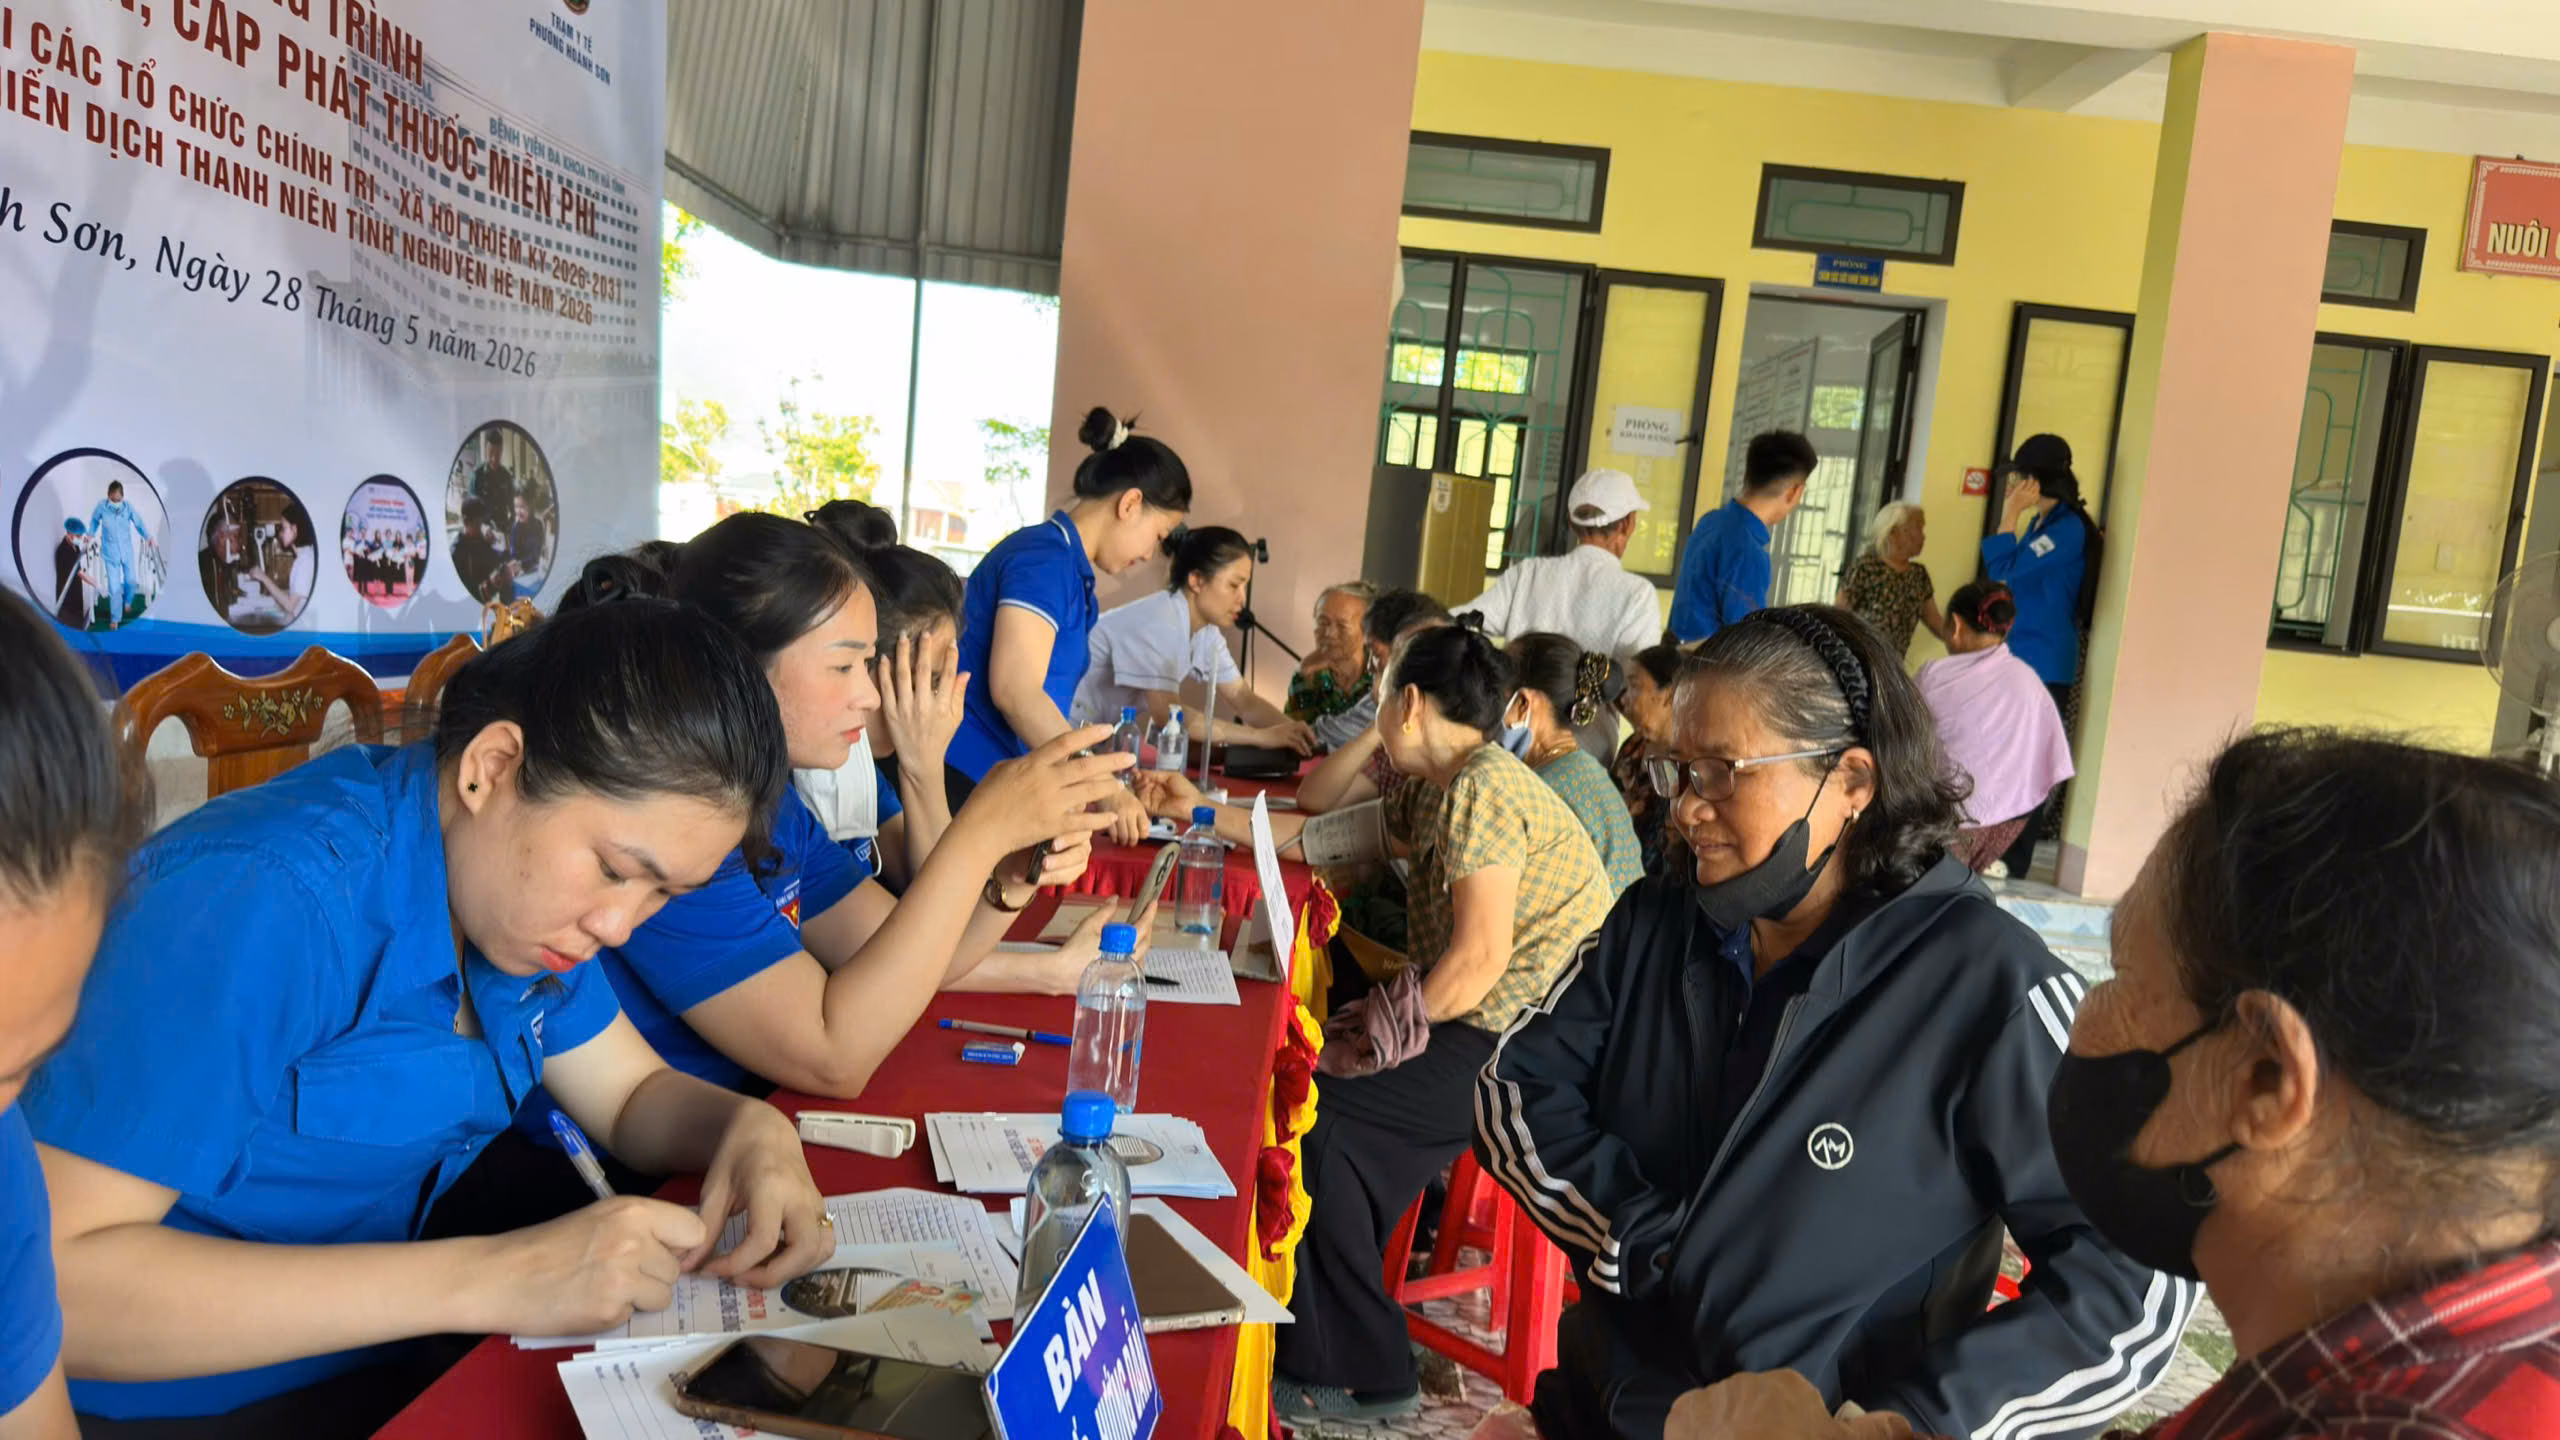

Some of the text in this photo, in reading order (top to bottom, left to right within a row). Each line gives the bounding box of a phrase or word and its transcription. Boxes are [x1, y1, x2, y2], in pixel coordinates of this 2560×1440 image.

[0, 65, 69, 133] IẾN
[86, 102, 163, 168] DỊCH
[176, 138, 269, 208] THANH
[279, 180, 337, 233] NIÊN
[494, 265, 514, 299] HÈ
[520, 276, 554, 313] NĂM
[559, 293, 593, 326] 2026
[31, 21, 102, 87] CÁC
[117, 58, 156, 109] TỔ
[169, 84, 245, 148] CHỨC
[257, 123, 333, 186] CHÍNH
[342, 160, 375, 212] TRỊ
[400, 186, 424, 226] XÃ
[431, 202, 461, 245] HỘI
[469, 218, 522, 265] NHIỆM
[528, 242, 547, 274] KỲ
[552, 255, 622, 304] 2026-2031
[278, 33, 371, 129] PHÁT
[384, 91, 478, 182] THUỐC
[560, 186, 597, 239] PHÍ
[43, 202, 137, 271] Sơn,
[155, 235, 250, 304] Ngày
[261, 270, 302, 312] 28
[316, 285, 395, 345] Tháng
[405, 314, 420, 345] 5
[428, 328, 477, 362] năm
[484, 338, 537, 378] 2026
[2487, 218, 2550, 259] NUÔI
[1043, 1266, 1107, 1414] BÀN
